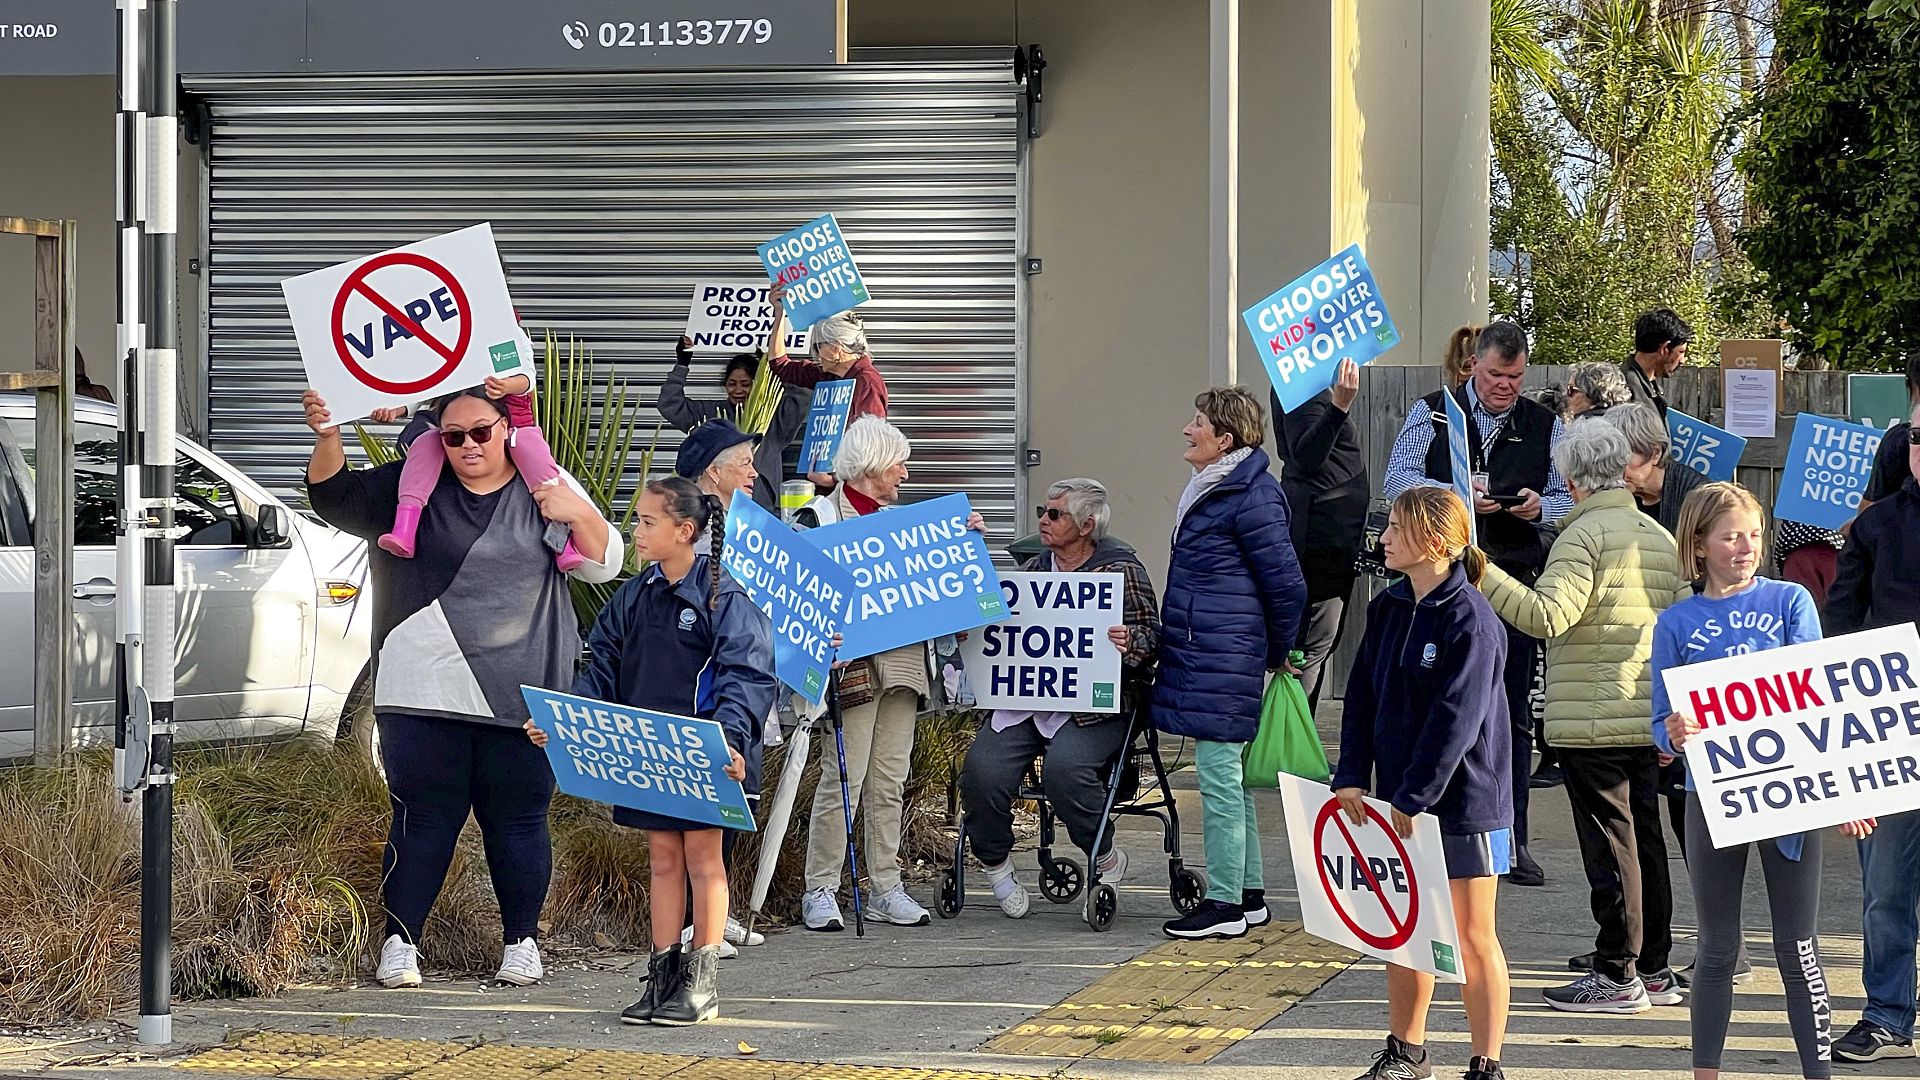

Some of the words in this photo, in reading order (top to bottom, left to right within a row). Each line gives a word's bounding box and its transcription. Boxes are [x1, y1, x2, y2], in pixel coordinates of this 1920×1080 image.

[12, 24, 58, 38] ROAD
[597, 18, 773, 48] 021133779
[767, 223, 836, 268] CHOOSE
[776, 260, 808, 286] KIDS
[808, 245, 846, 272] OVER
[785, 261, 856, 310] PROFITS
[1258, 255, 1361, 333] CHOOSE
[343, 286, 458, 359] VAPE
[705, 305, 748, 318] OUR
[1269, 316, 1316, 356] KIDS
[1319, 281, 1373, 324] OVER
[1276, 300, 1383, 384] PROFITS
[813, 387, 829, 406] NO
[830, 385, 851, 405] VAPE
[811, 414, 841, 437] STORE
[808, 440, 832, 462] HERE
[1690, 434, 1721, 475] NO
[1804, 467, 1858, 489] GOOD
[889, 516, 968, 551] WINS
[735, 517, 790, 576] YOUR
[795, 562, 843, 614] VAPE
[904, 541, 978, 576] MORE
[722, 543, 837, 639] REGULATIONS
[1029, 581, 1113, 610] VAPE
[777, 614, 829, 664] JOKE
[981, 624, 1094, 659] STORE
[1687, 618, 1723, 653] ITS
[1728, 610, 1784, 641] COOL
[990, 664, 1078, 699] HERE
[1688, 667, 1826, 730] HONK
[1824, 651, 1919, 703] FOR
[543, 698, 658, 741] THERE
[667, 722, 704, 749] IS
[553, 721, 711, 769] NOTHING
[1704, 728, 1785, 775] NO
[1796, 700, 1920, 753] VAPE
[566, 743, 633, 768] GOOD
[640, 759, 712, 784] ABOUT
[572, 757, 720, 803] NICOTINE
[1720, 770, 1840, 819] STORE
[1321, 855, 1409, 893] VAPE
[1796, 936, 1831, 1061] BROOKLYN
